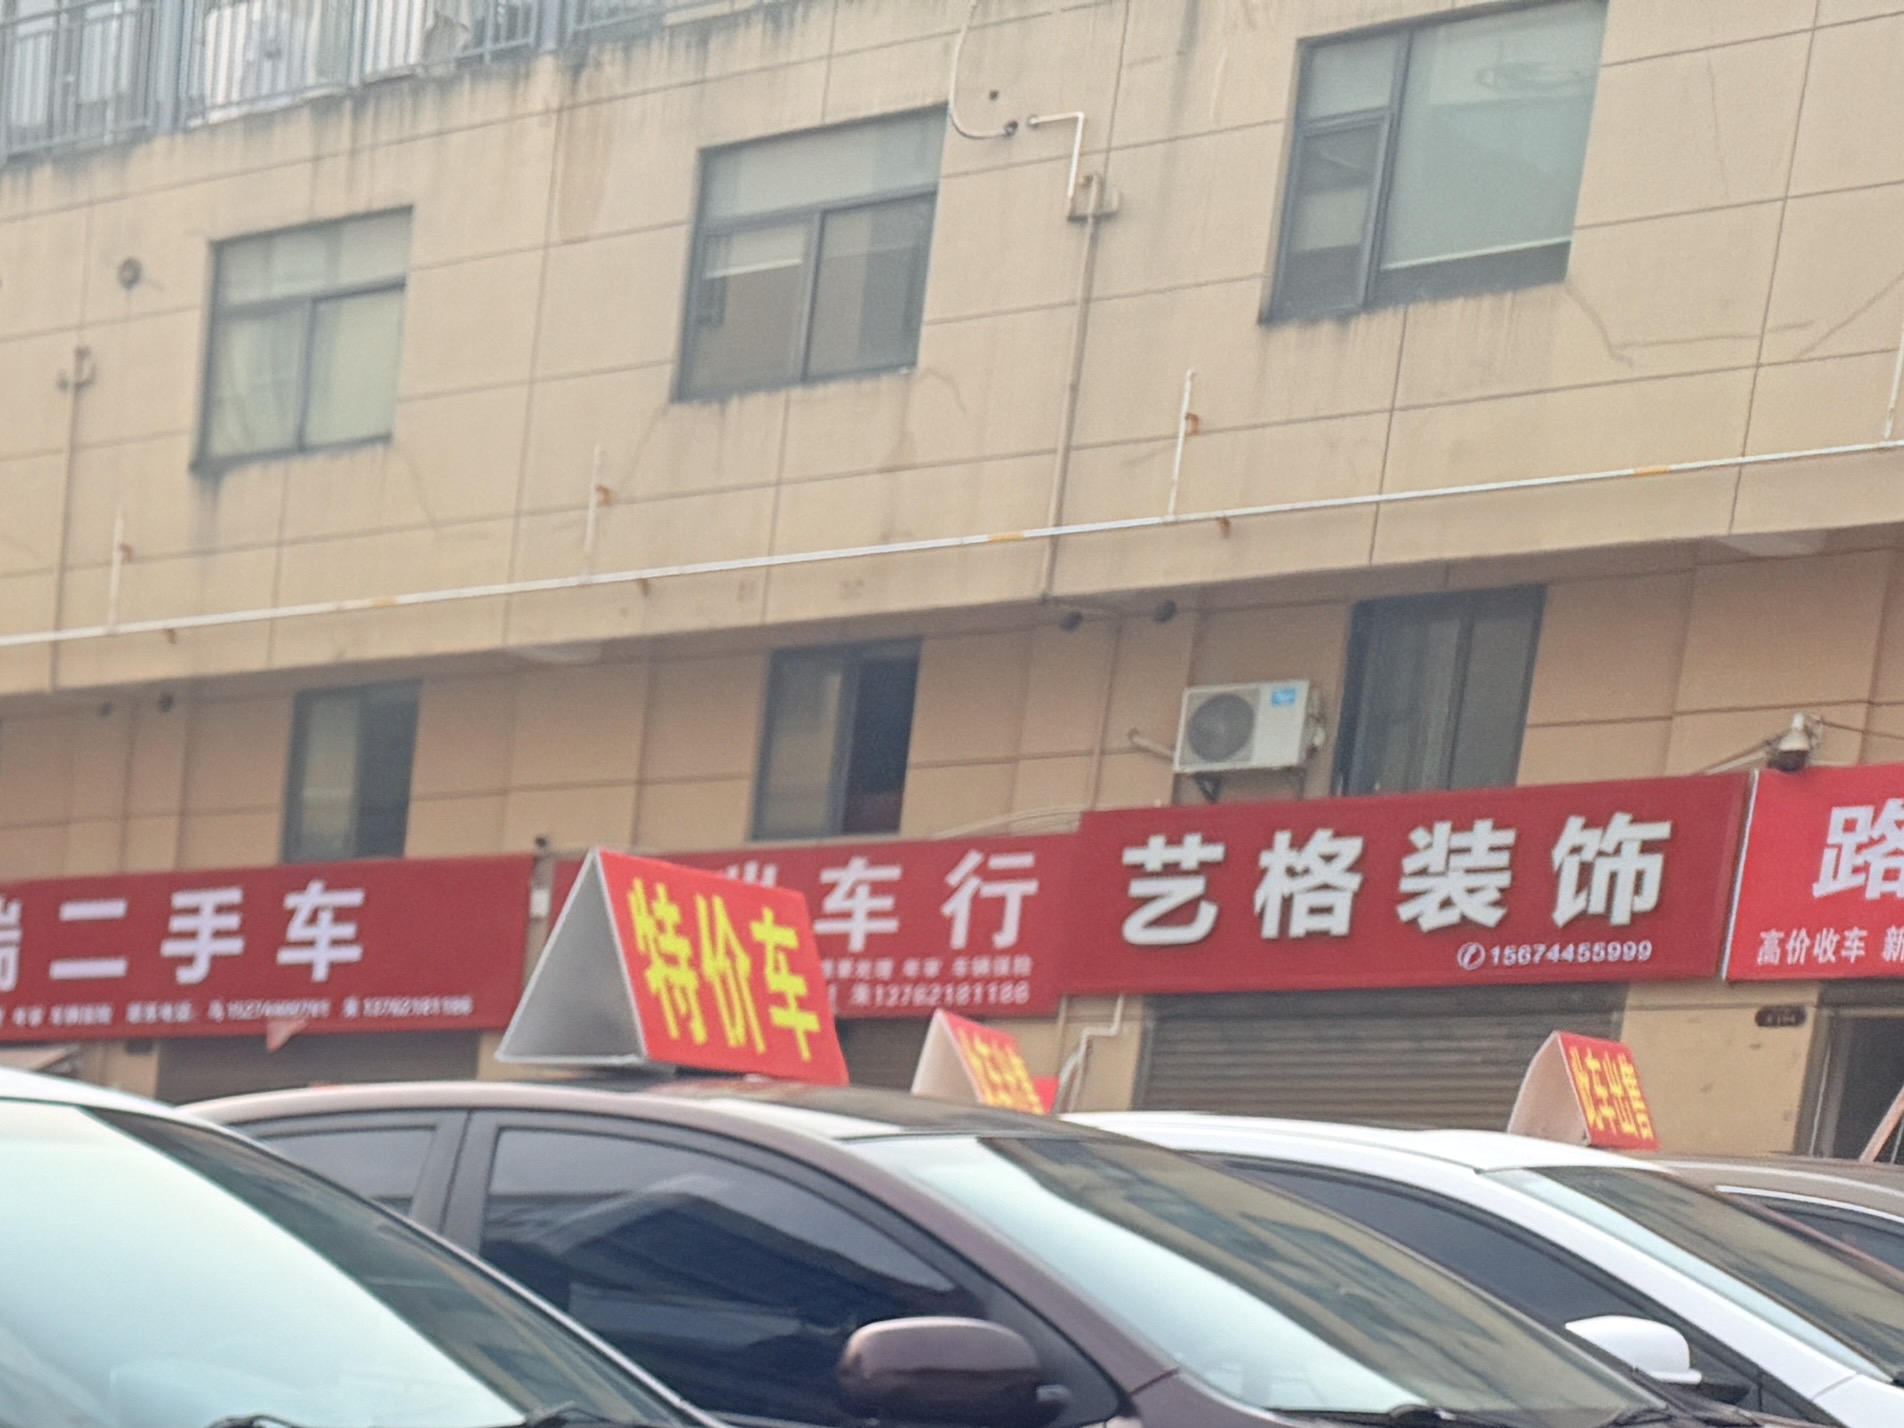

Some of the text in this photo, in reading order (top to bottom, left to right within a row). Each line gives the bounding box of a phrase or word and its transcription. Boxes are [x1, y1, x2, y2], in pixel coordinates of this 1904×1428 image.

[724, 849, 1039, 953] 车行
[1121, 812, 1672, 946] 艺格装饰
[626, 877, 820, 1062] 特价车
[1756, 926, 1869, 966] 高价收车
